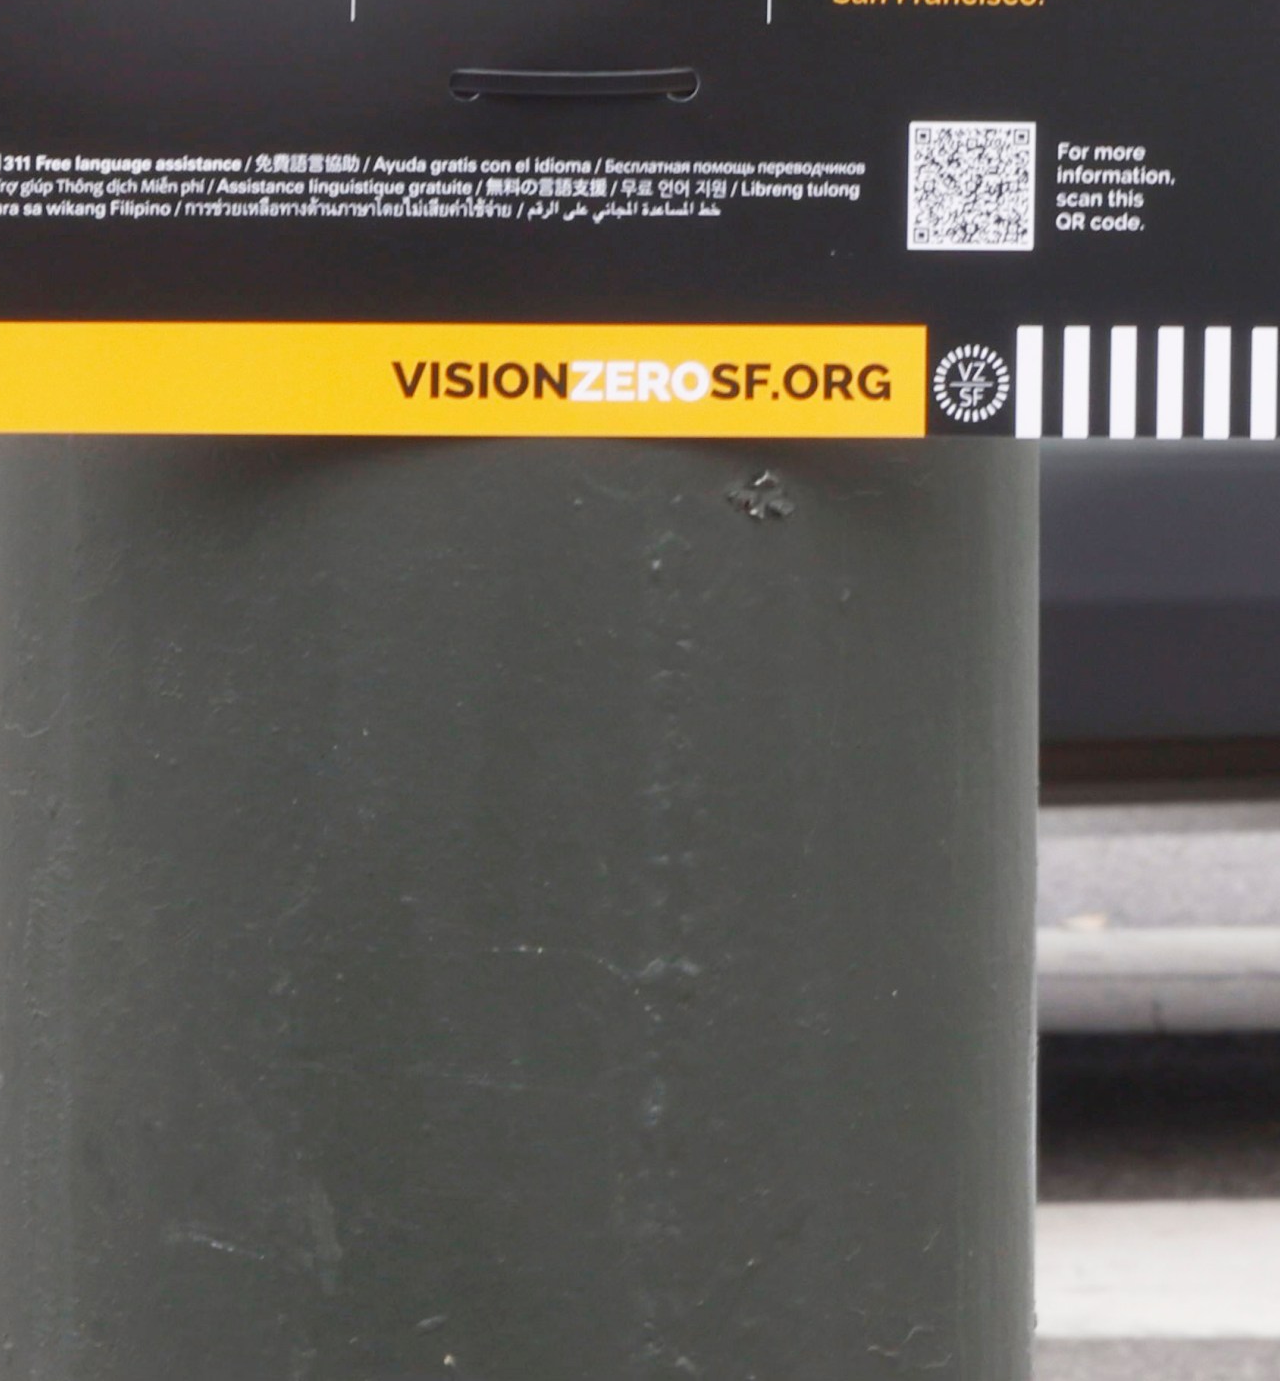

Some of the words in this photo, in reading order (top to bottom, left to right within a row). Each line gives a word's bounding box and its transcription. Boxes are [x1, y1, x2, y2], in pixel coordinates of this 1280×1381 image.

[1057, 142, 1090, 161] For
[1094, 145, 1146, 161] more
[3, 155, 31, 171] 311
[35, 155, 71, 171] Free
[75, 154, 152, 174] language
[156, 155, 242, 172] assistance
[373, 156, 426, 176] Ayuda
[430, 157, 477, 175] gratis
[480, 159, 511, 173] con
[515, 157, 530, 173] el
[535, 157, 591, 173] idioma
[1056, 165, 1176, 186] information,
[216, 179, 304, 195] Assistance
[308, 179, 404, 196] linguistique
[408, 179, 472, 197] gratuite
[741, 181, 803, 200] Libreng
[807, 181, 861, 201] tulong
[1056, 191, 1103, 207] scan
[1108, 189, 1144, 207] this
[23, 203, 42, 216] sa
[46, 200, 106, 219] wikang
[110, 201, 171, 219] Filipino
[1056, 212, 1085, 231] QR
[1090, 213, 1145, 231] code.
[392, 361, 891, 402] VISIONZEROSF.ORG
[958, 362, 987, 382] VZ
[959, 389, 984, 408] SF
